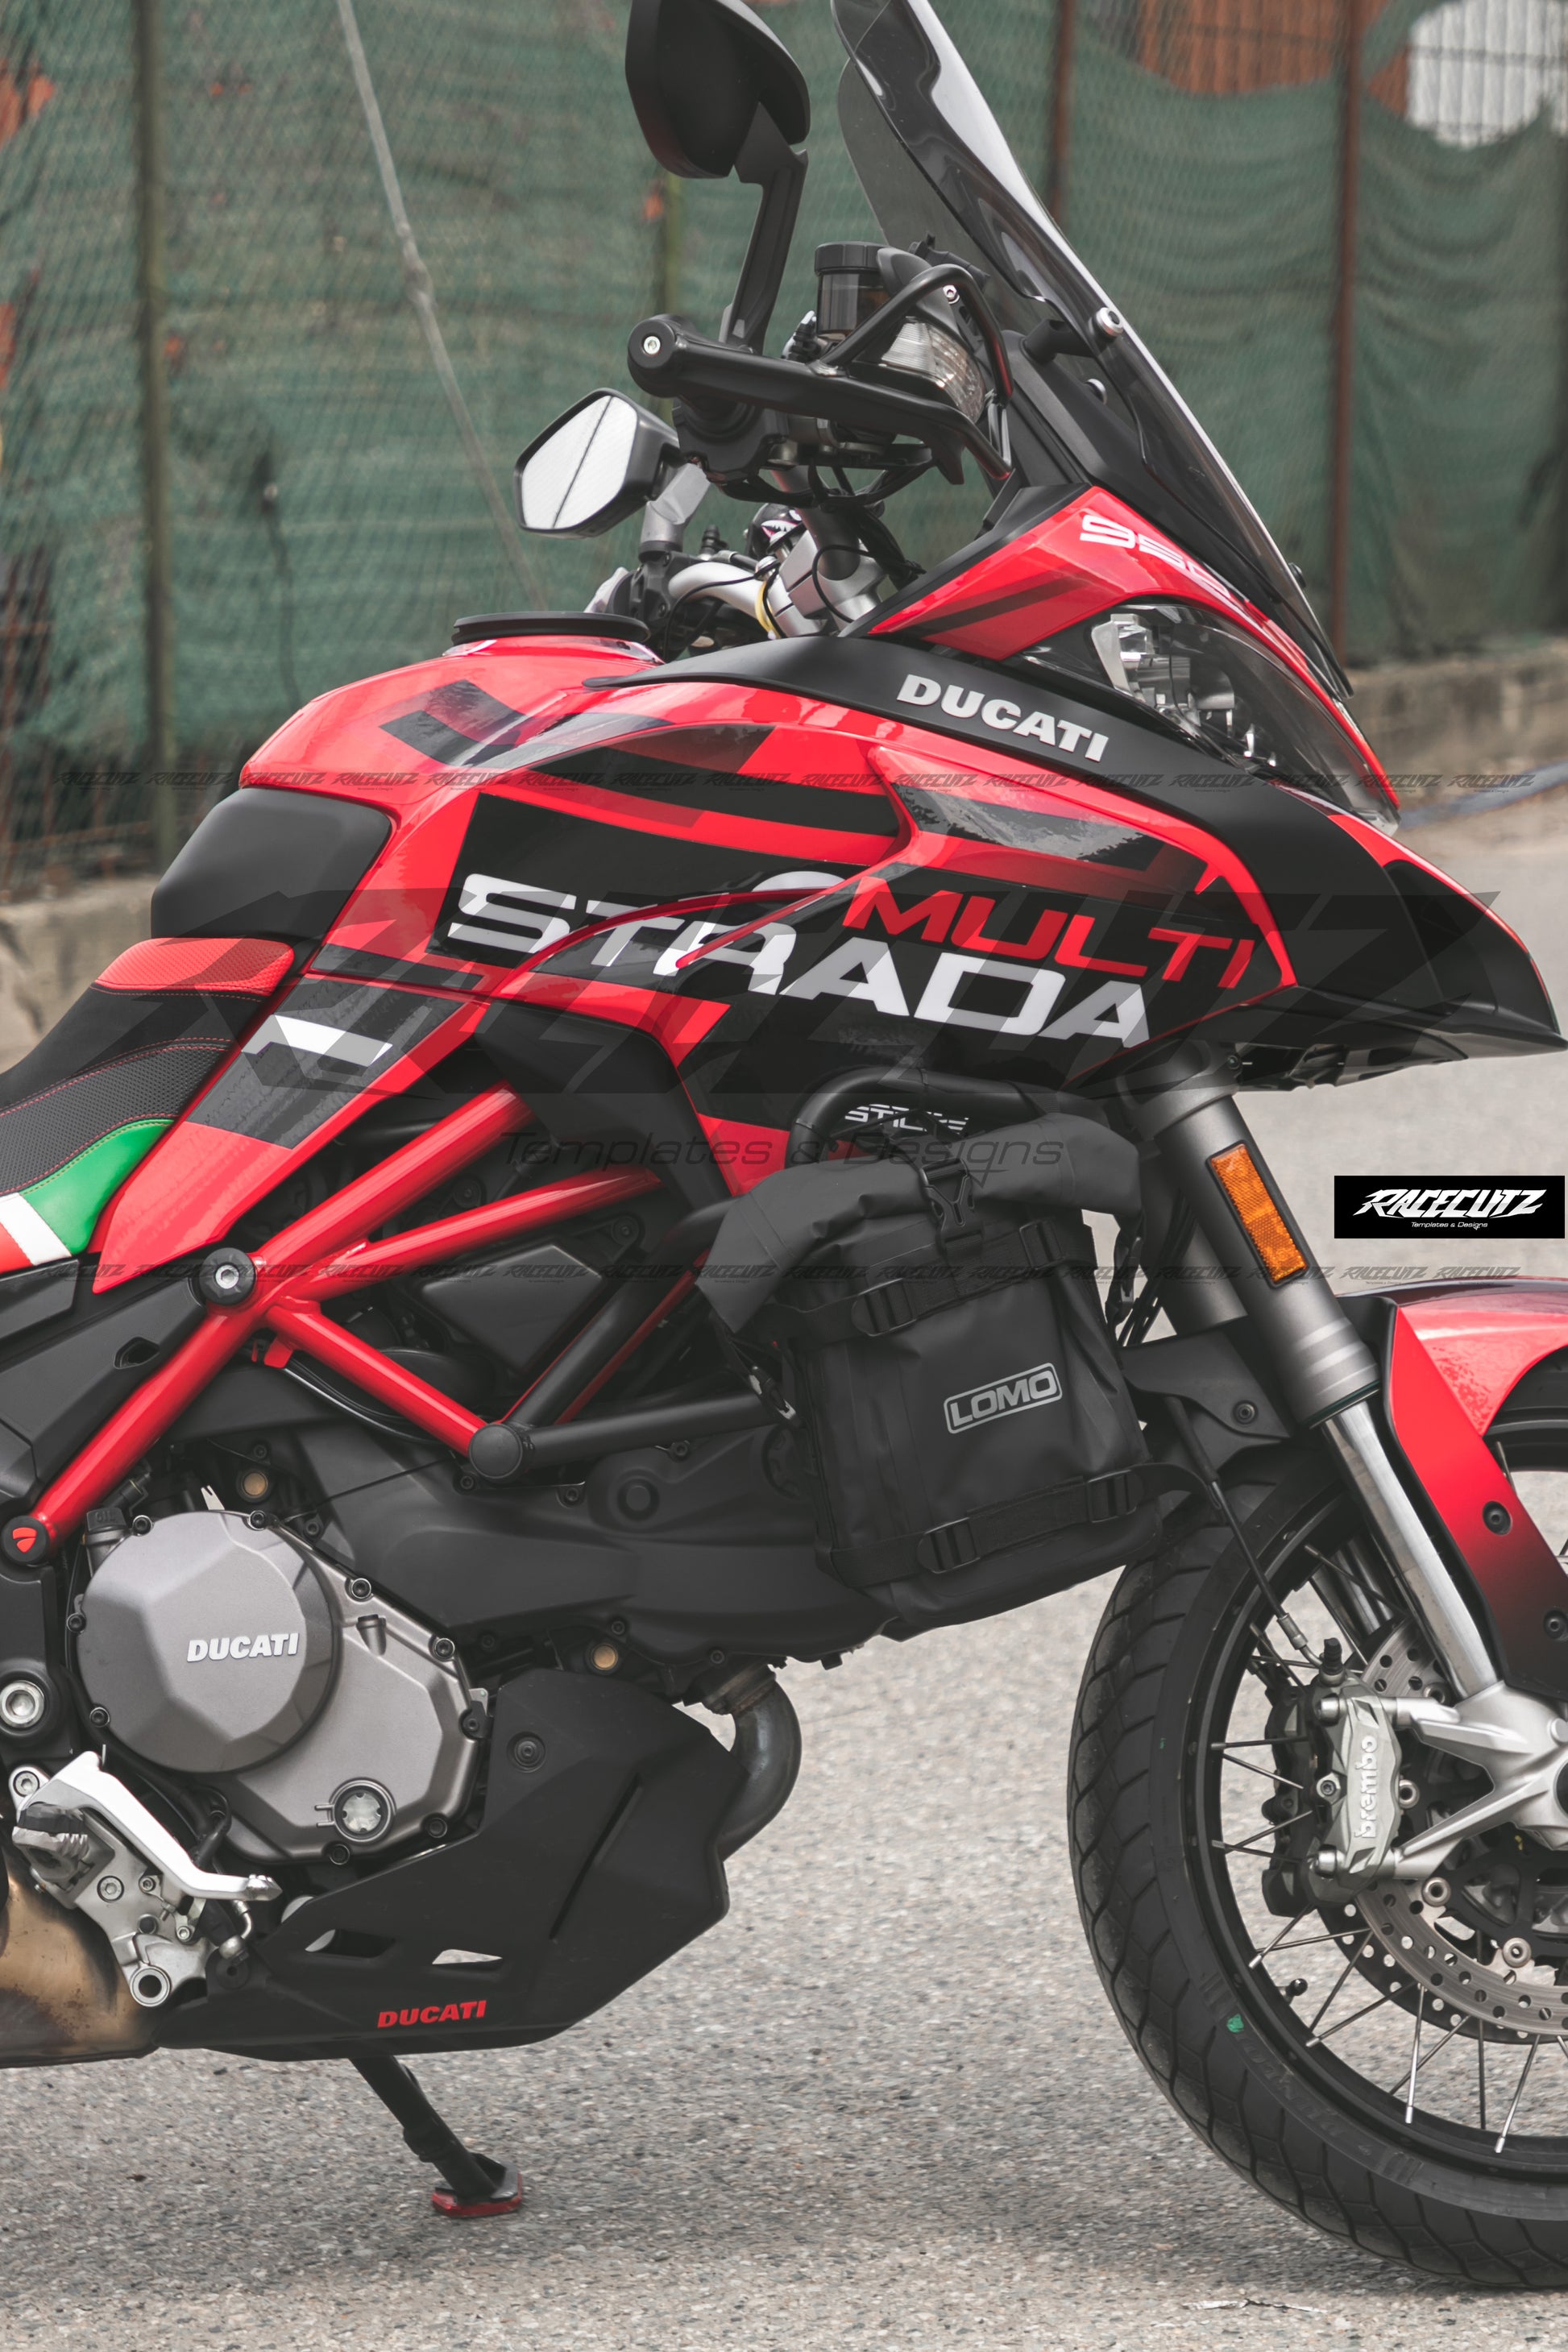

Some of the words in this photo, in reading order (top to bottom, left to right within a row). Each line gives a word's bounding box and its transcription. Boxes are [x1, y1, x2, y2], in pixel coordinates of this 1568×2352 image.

[896, 674, 1109, 762] DUCATI
[448, 873, 1150, 1048] STRADA
[843, 876, 1254, 988] MULTI
[950, 1370, 1057, 1427] LOMO
[187, 1632, 299, 1663] DUCATI
[1354, 1736, 1378, 1838] brembo
[377, 2000, 487, 2028] DUCATI
